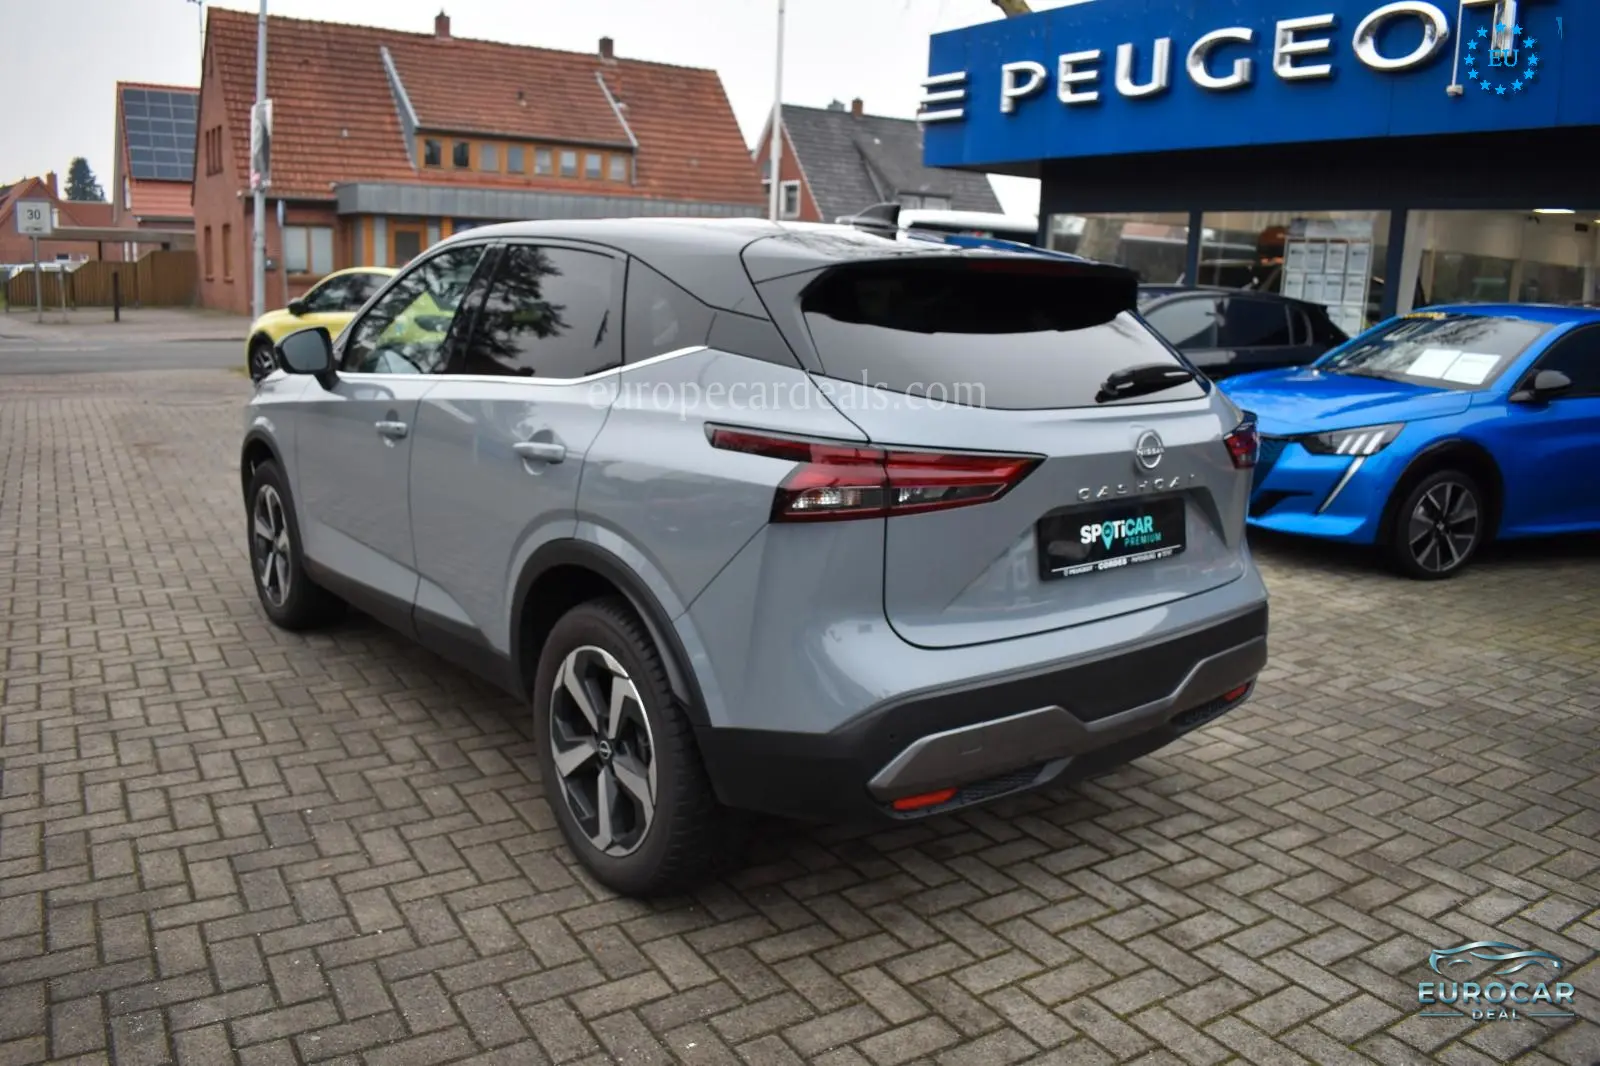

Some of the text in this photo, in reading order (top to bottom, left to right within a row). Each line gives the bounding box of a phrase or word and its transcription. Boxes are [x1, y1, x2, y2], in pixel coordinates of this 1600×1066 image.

[1001, 0, 1524, 113] PEUGEOT
[26, 209, 41, 220] 30
[1124, 531, 1162, 547] PREMIUM
